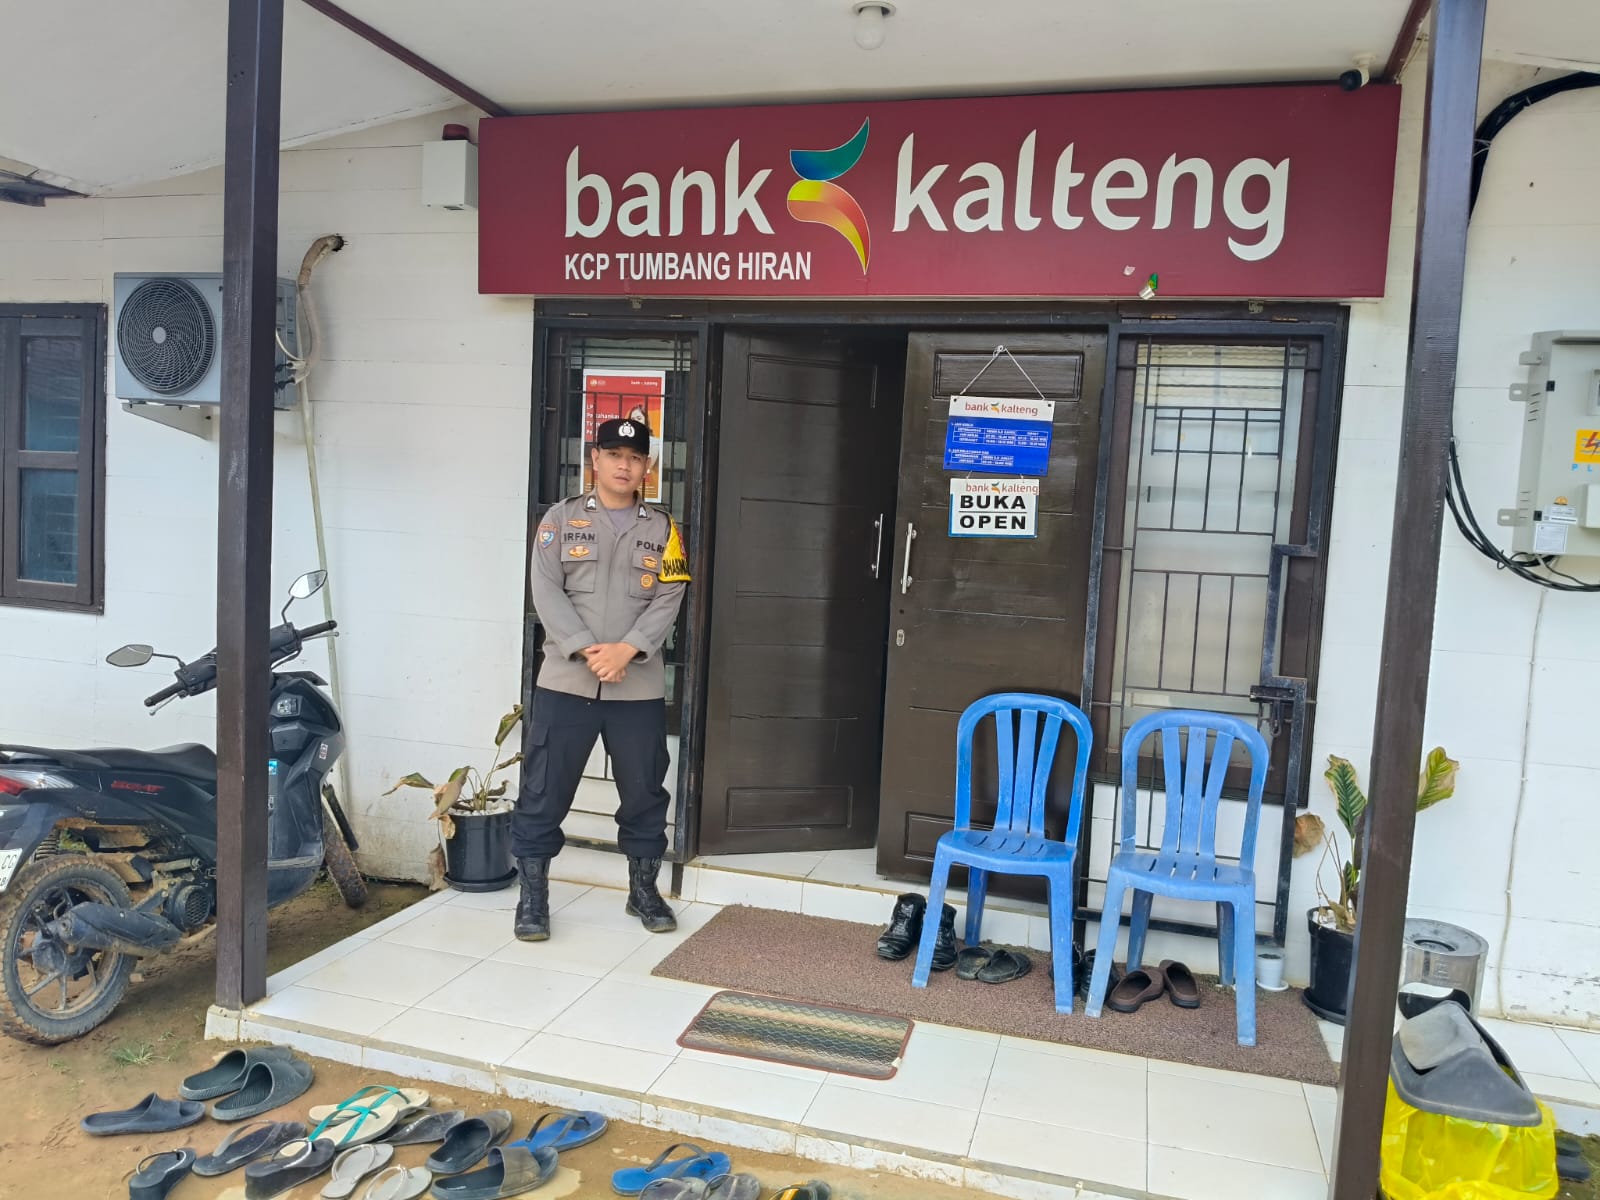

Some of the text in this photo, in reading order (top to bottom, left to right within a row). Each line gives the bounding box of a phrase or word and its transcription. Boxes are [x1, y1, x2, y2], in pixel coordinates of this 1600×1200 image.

[564, 129, 1290, 262] bank kalteng
[565, 251, 812, 281] KCP TUMBANG HIRAN
[965, 402, 1039, 417] bank kalteng
[965, 484, 1039, 496] bank kalteng
[960, 495, 1026, 509] BUKA
[959, 515, 1026, 530] OPEN
[563, 532, 596, 542] IRFAN
